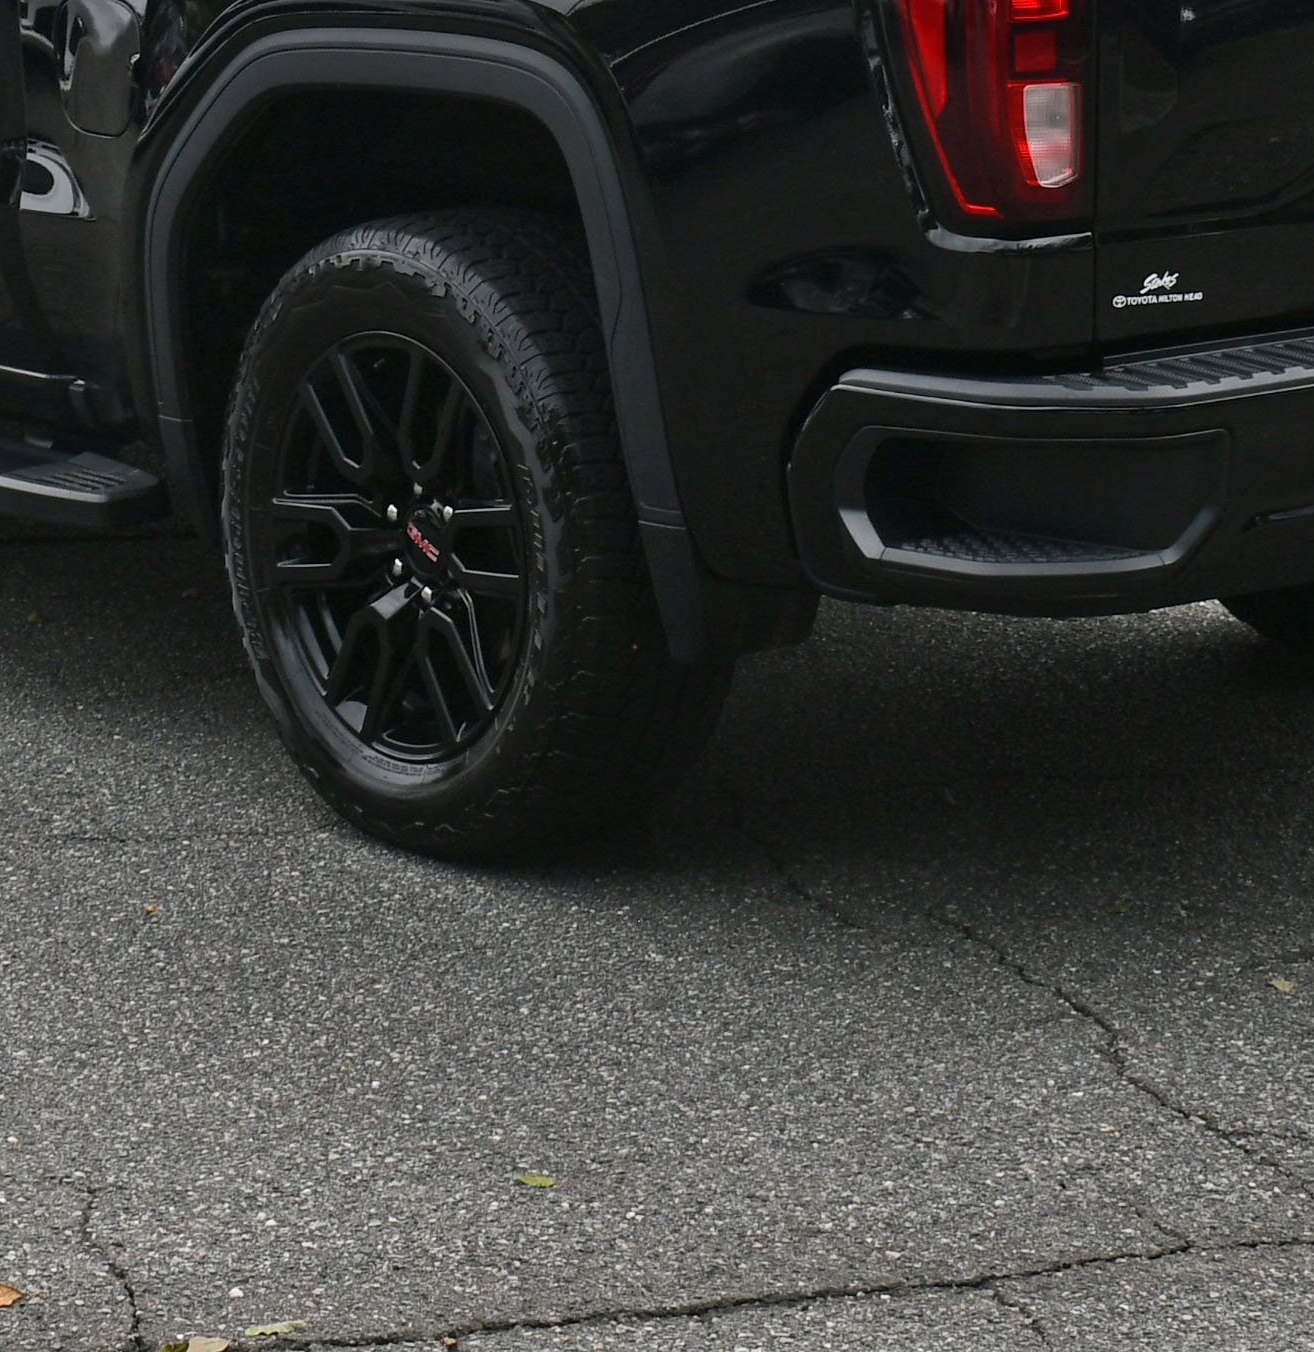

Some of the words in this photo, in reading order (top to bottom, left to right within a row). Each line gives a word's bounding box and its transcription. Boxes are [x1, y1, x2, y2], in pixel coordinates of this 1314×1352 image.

[1126, 295, 1157, 305] TOYOTA
[1158, 293, 1183, 303] HILTON
[1184, 292, 1203, 301] HEAD
[406, 522, 440, 563] GMC
